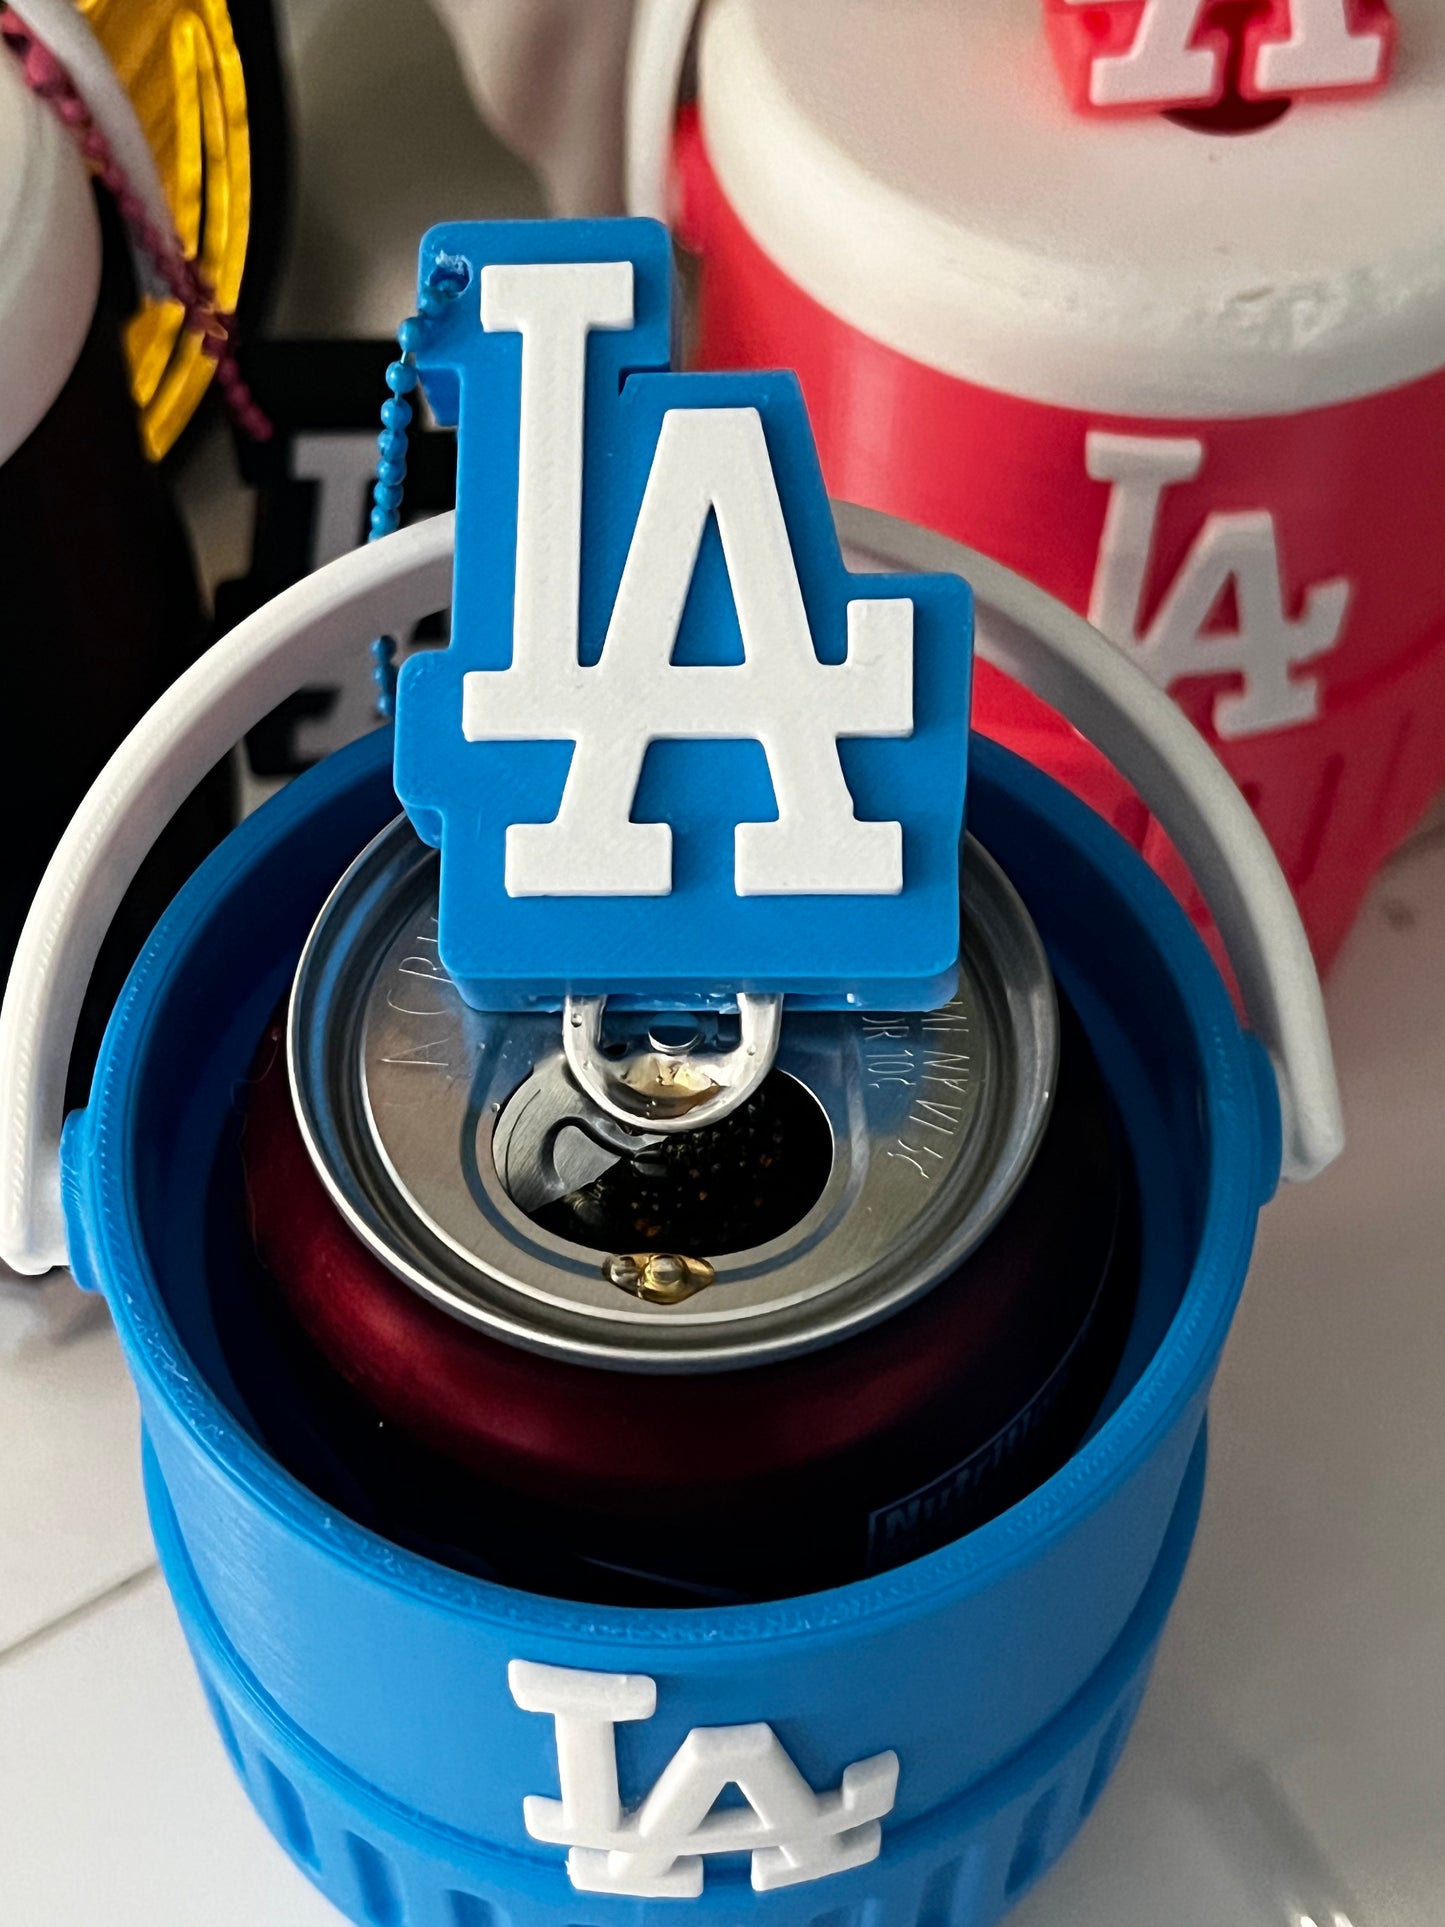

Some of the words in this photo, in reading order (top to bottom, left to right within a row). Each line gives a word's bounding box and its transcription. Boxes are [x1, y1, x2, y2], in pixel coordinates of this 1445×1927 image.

[462, 260, 915, 897] LA
[1085, 429, 1352, 742] LA
[508, 1658, 900, 1898] LA
